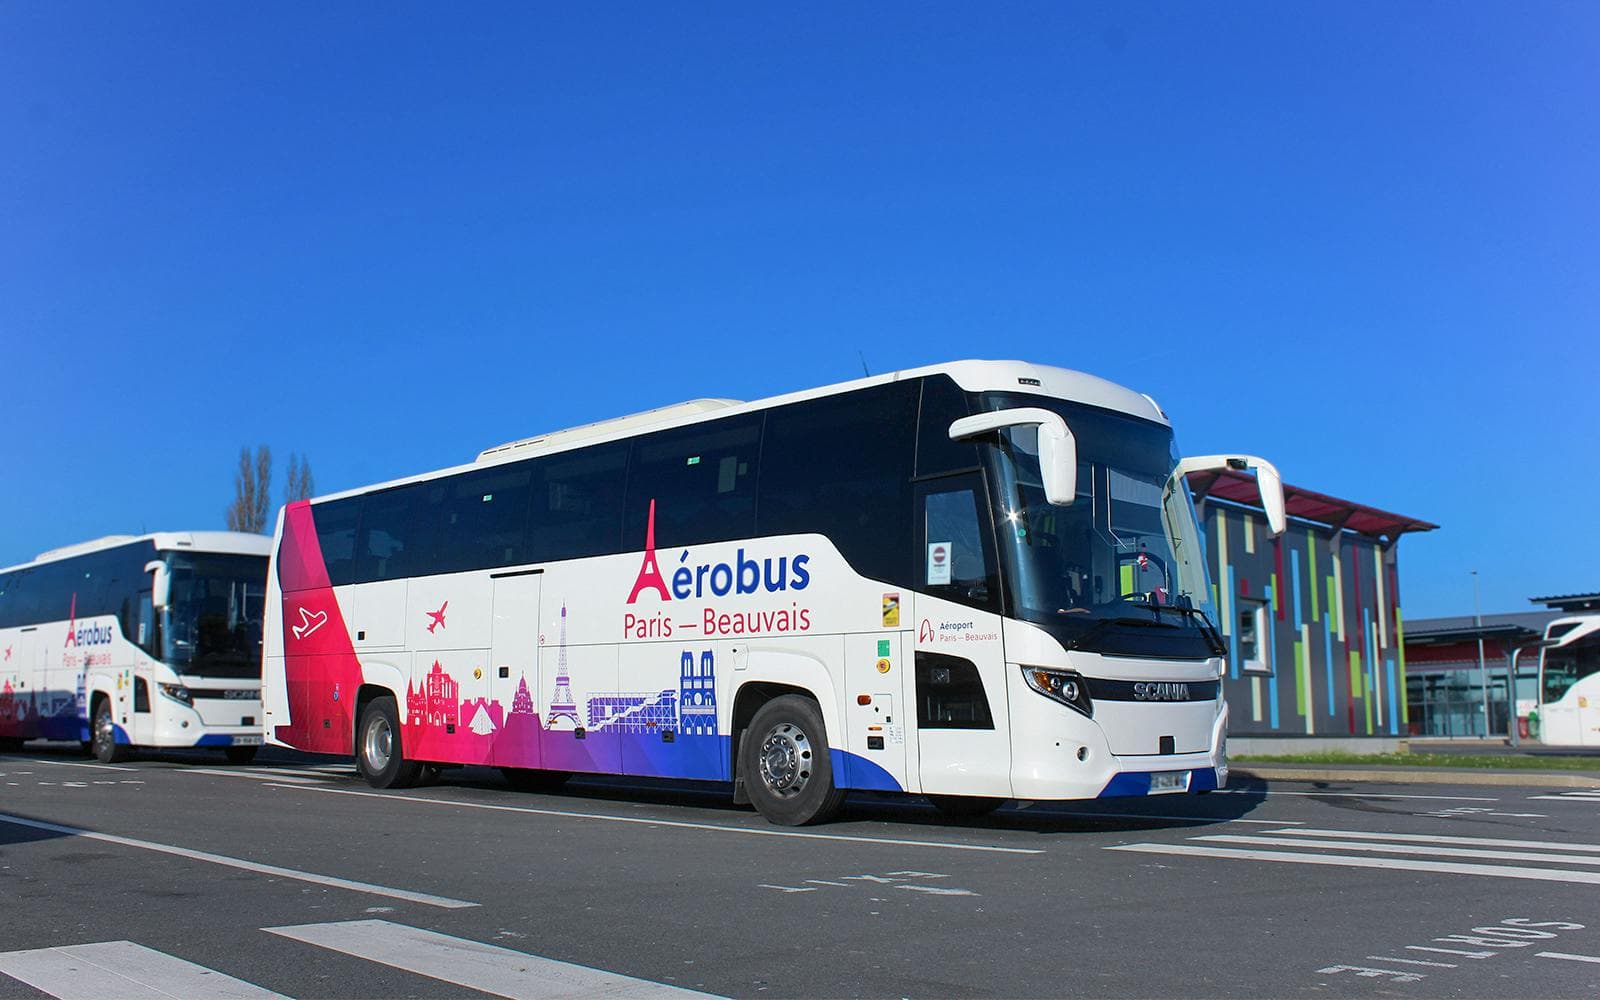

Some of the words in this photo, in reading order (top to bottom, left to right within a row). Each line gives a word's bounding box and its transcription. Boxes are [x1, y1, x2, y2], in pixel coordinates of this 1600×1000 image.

[627, 499, 810, 603] Aérobus
[64, 592, 112, 647] Aérobus
[624, 611, 673, 640] Paris
[703, 602, 811, 636] Beauvais
[940, 621, 973, 631] Aéroport
[940, 634, 957, 642] Paris
[966, 632, 998, 641] Beauvais
[1134, 682, 1190, 701] SCANIA
[1315, 918, 1586, 983] SORTIE
